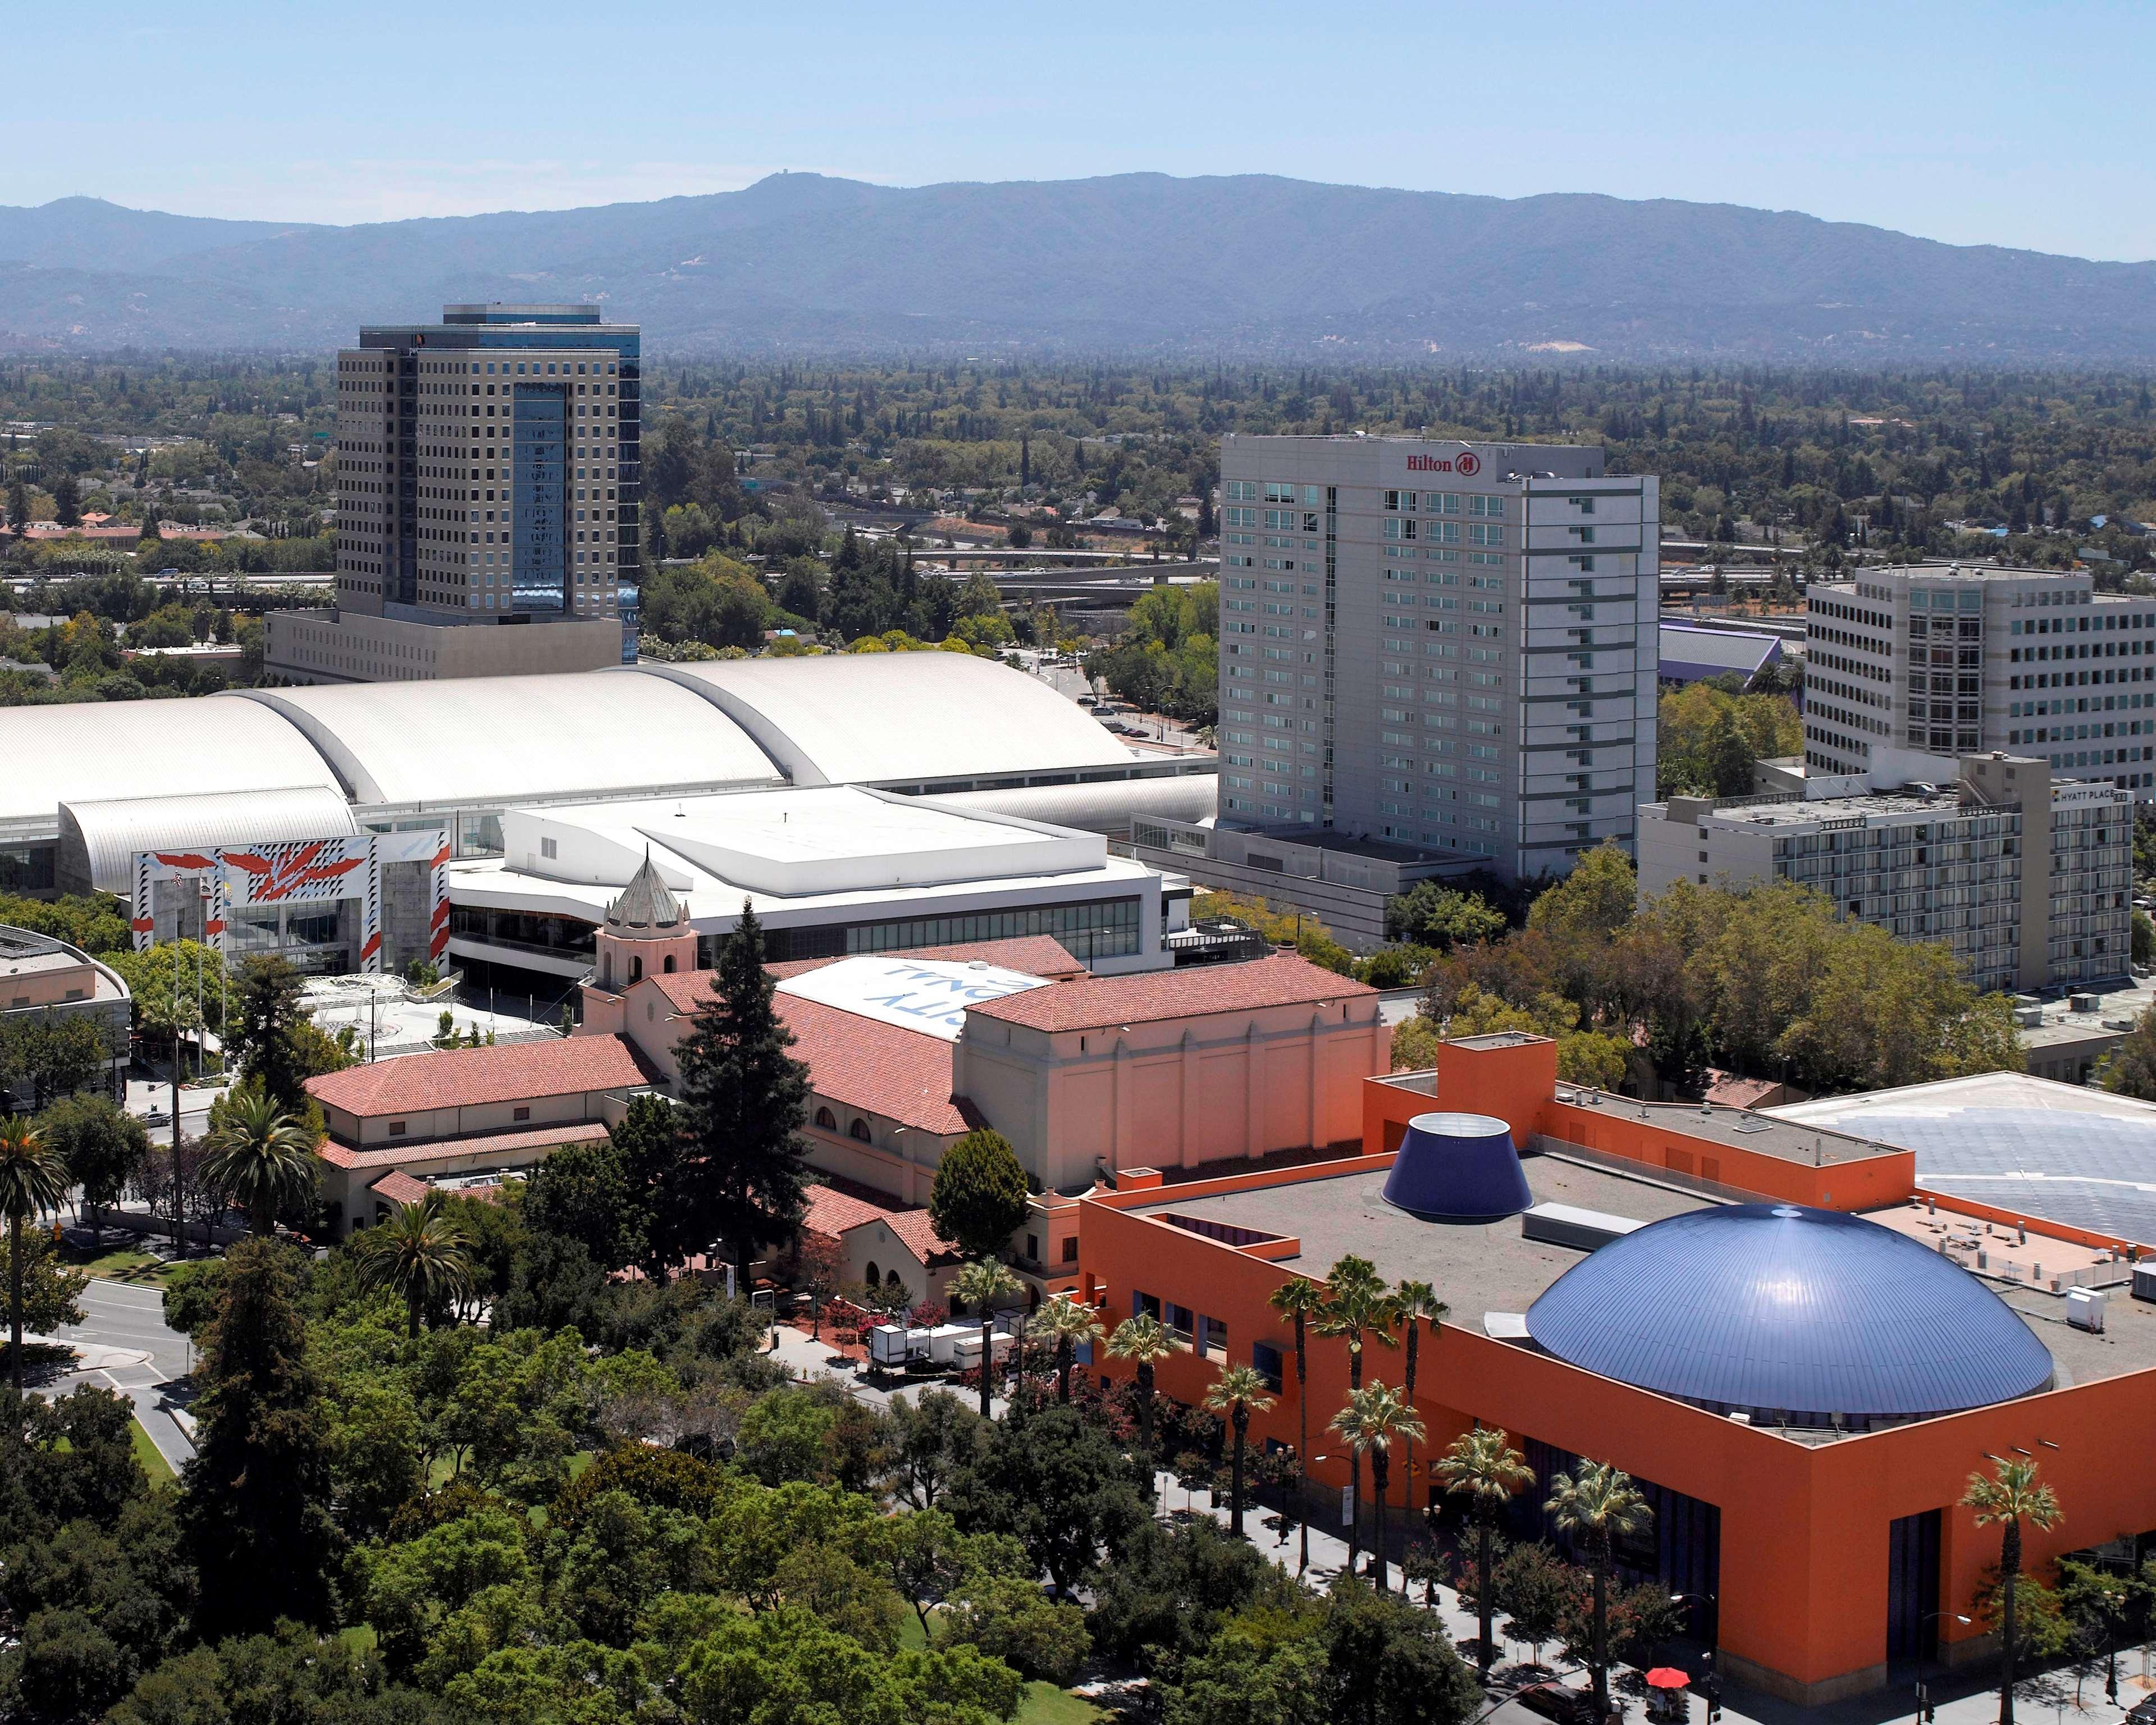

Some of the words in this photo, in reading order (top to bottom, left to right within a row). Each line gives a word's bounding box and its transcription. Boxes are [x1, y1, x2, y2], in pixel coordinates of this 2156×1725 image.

[1406, 454, 1452, 472] Hilton
[2061, 791, 2086, 802] HYATT
[2089, 789, 2115, 800] PLACE
